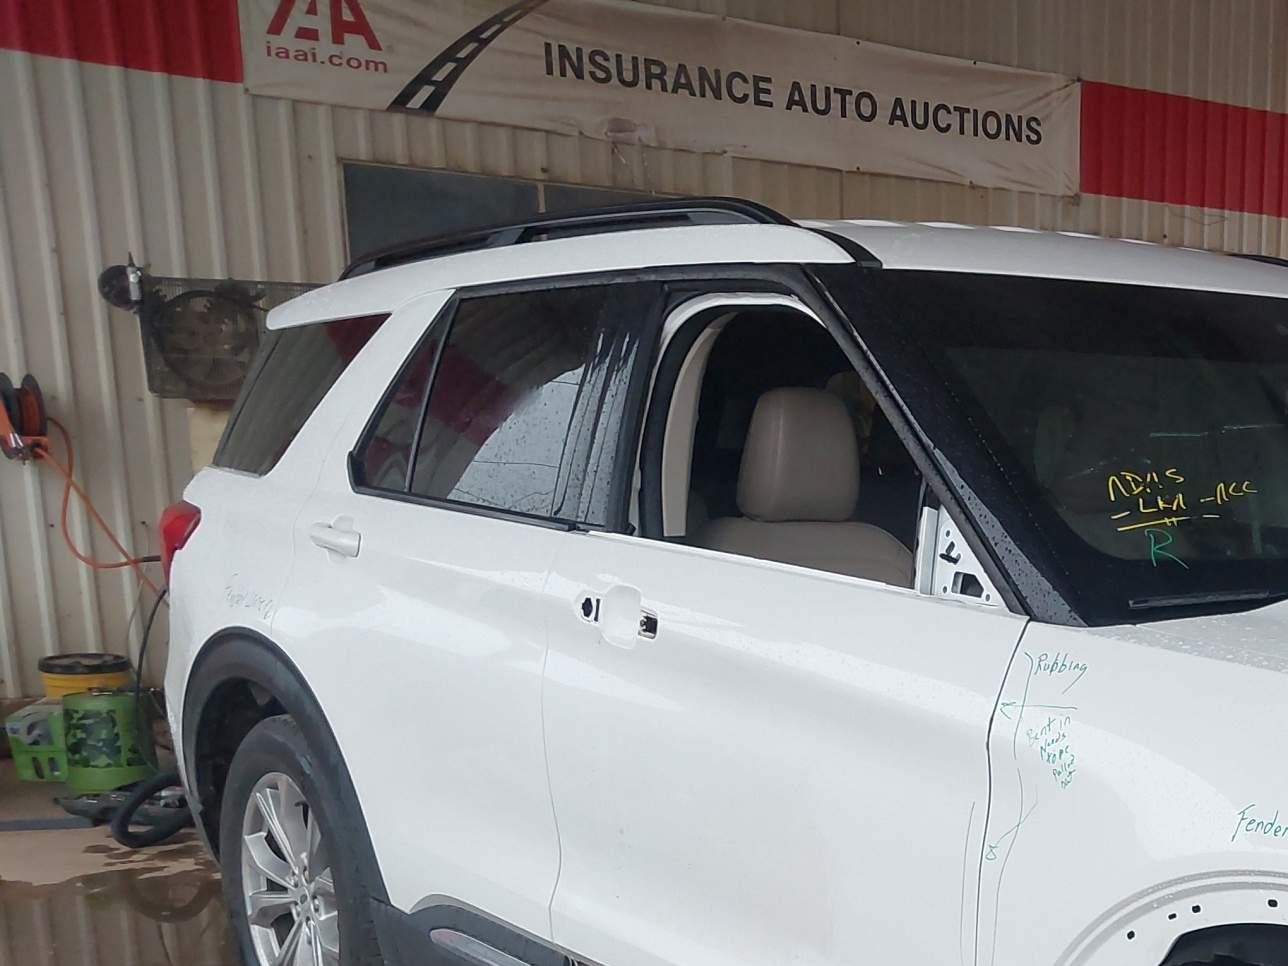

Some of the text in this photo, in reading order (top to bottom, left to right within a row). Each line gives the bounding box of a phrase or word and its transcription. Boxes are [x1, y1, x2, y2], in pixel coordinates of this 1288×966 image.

[266, 41, 388, 73] iaai.com
[544, 42, 1042, 145] INSURANCE AUTO AUCTIONS
[1144, 528, 1189, 569] R
